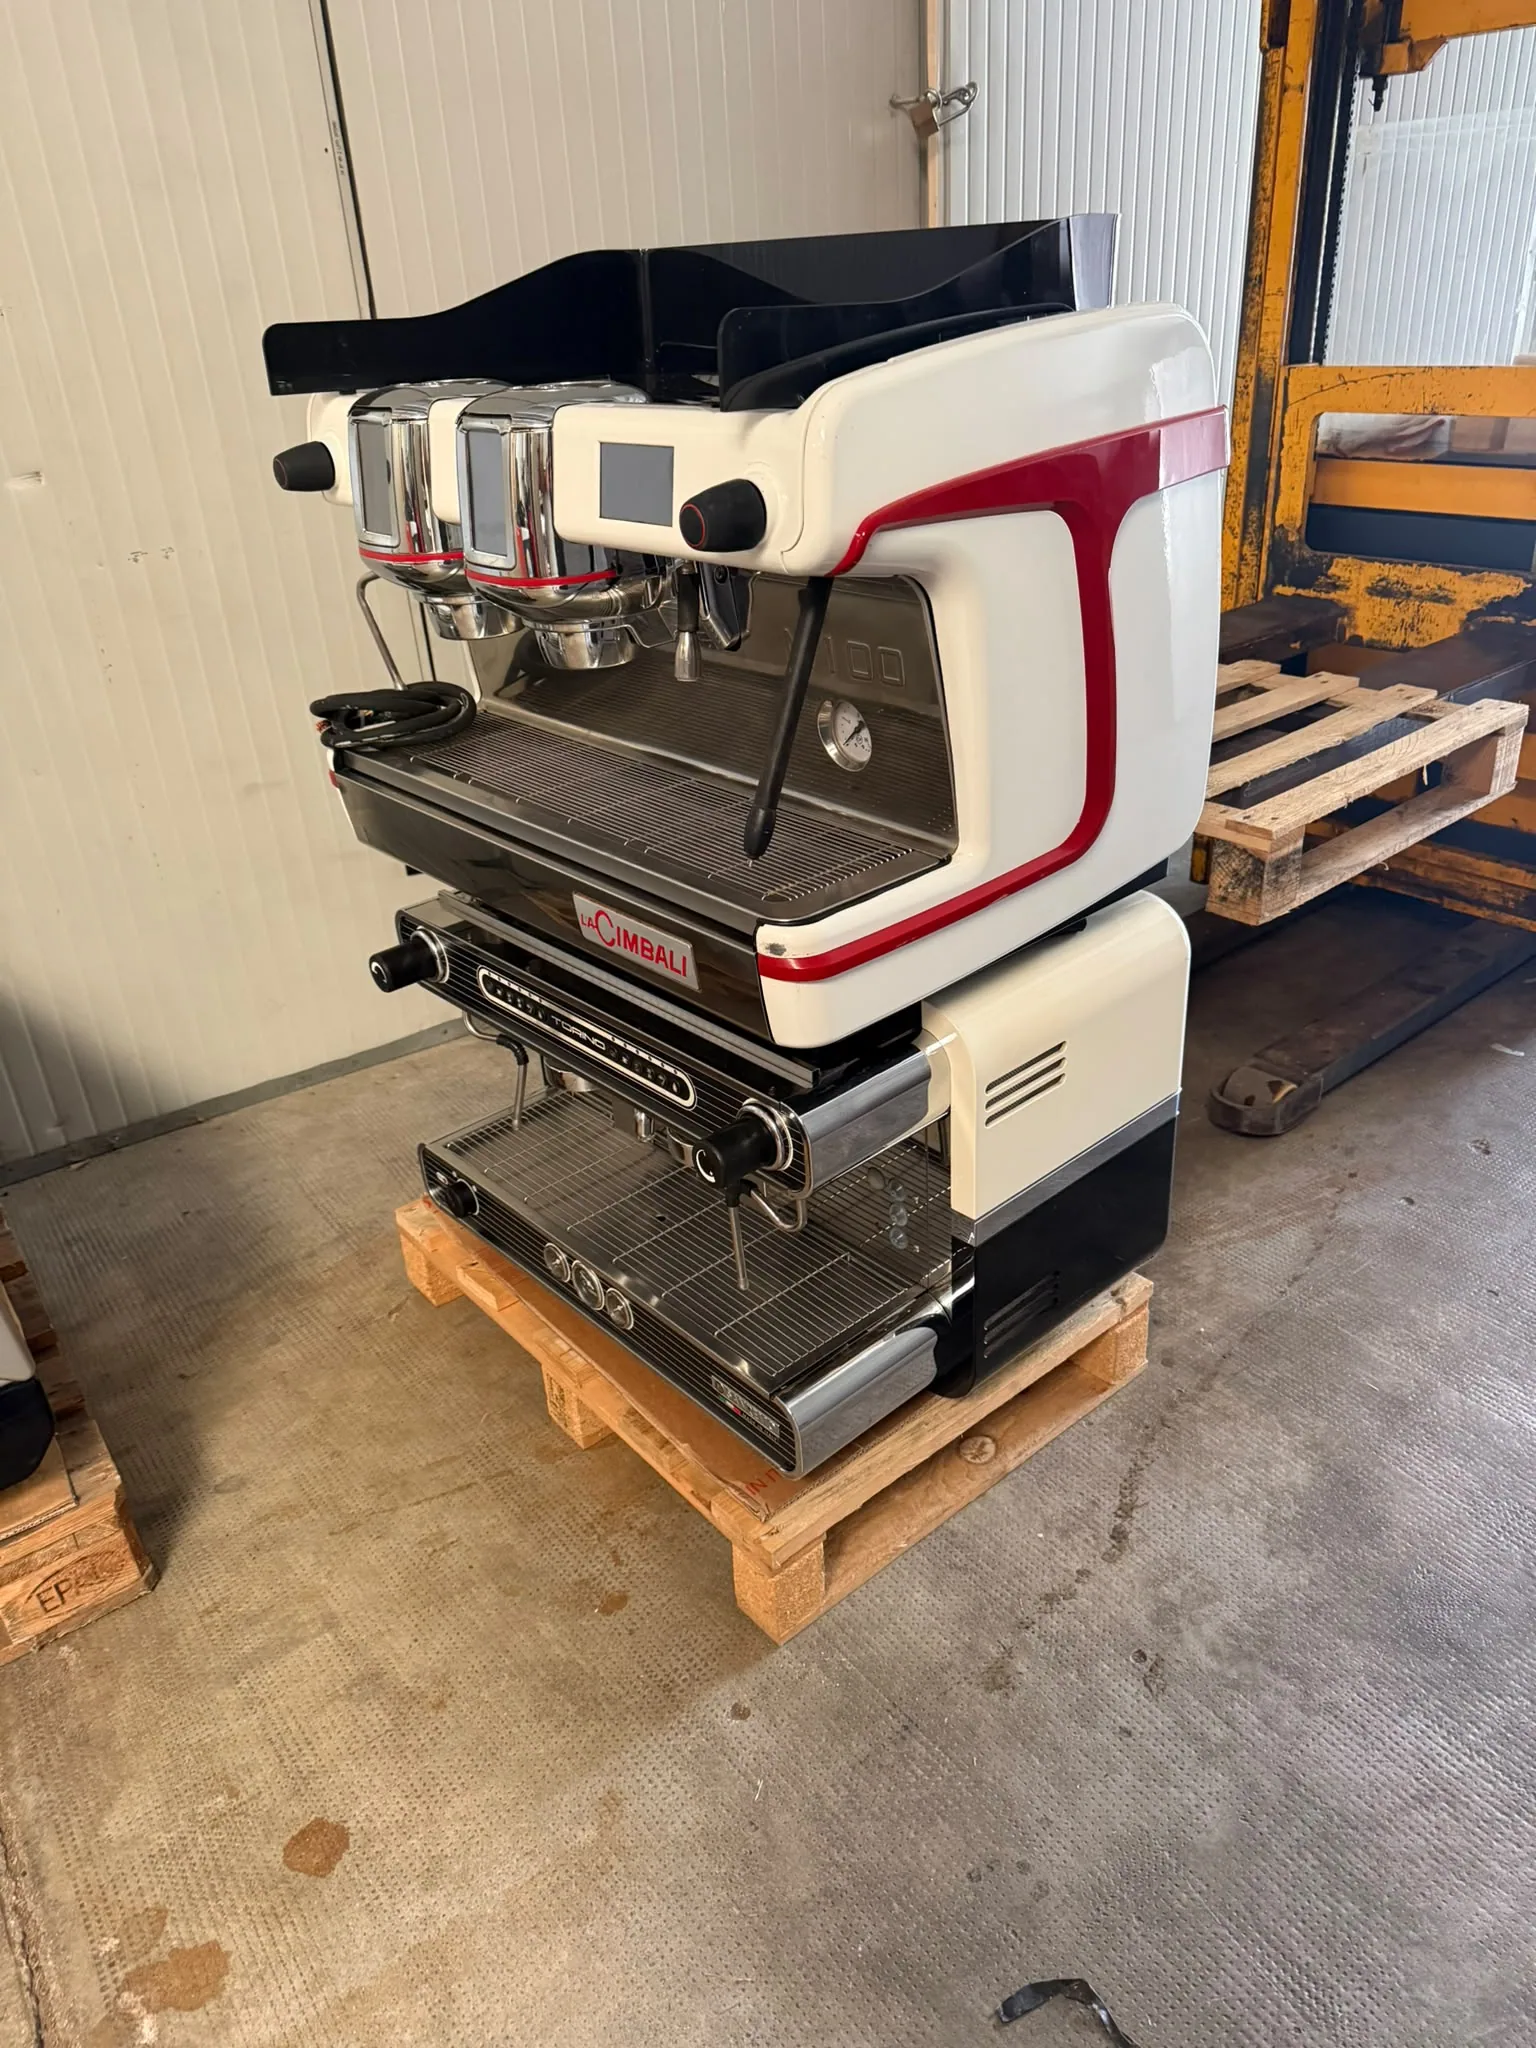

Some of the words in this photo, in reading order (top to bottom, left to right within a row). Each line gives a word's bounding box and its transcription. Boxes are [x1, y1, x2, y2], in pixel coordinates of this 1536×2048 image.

[580, 913, 596, 929] LA
[595, 909, 687, 977] CIMBALI
[551, 1015, 606, 1050] TORINO
